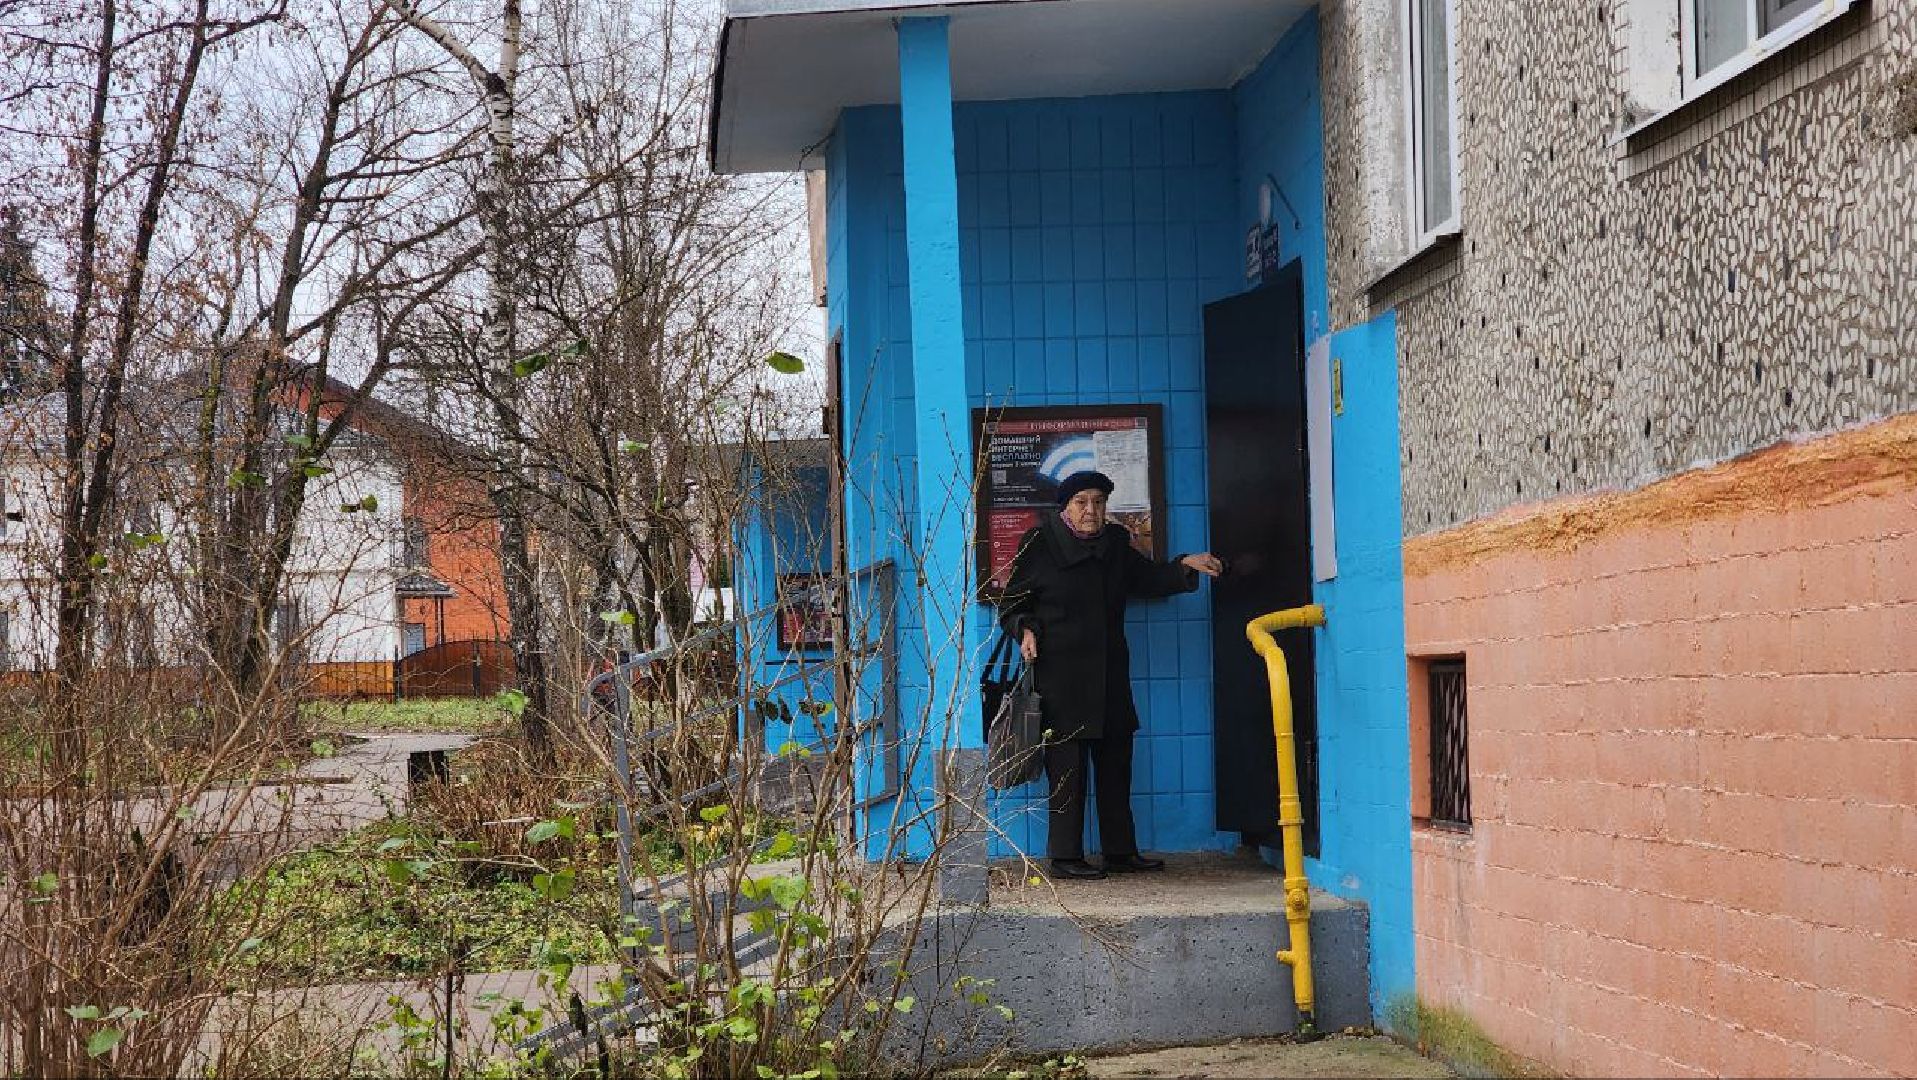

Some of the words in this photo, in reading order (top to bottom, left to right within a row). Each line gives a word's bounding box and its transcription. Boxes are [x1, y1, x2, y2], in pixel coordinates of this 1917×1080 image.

[991, 434, 1041, 445] ДОМАШНИЙ
[992, 445, 1034, 453] ИНТЕРНЕТ
[991, 452, 1041, 462] БЕСПЛАТНО
